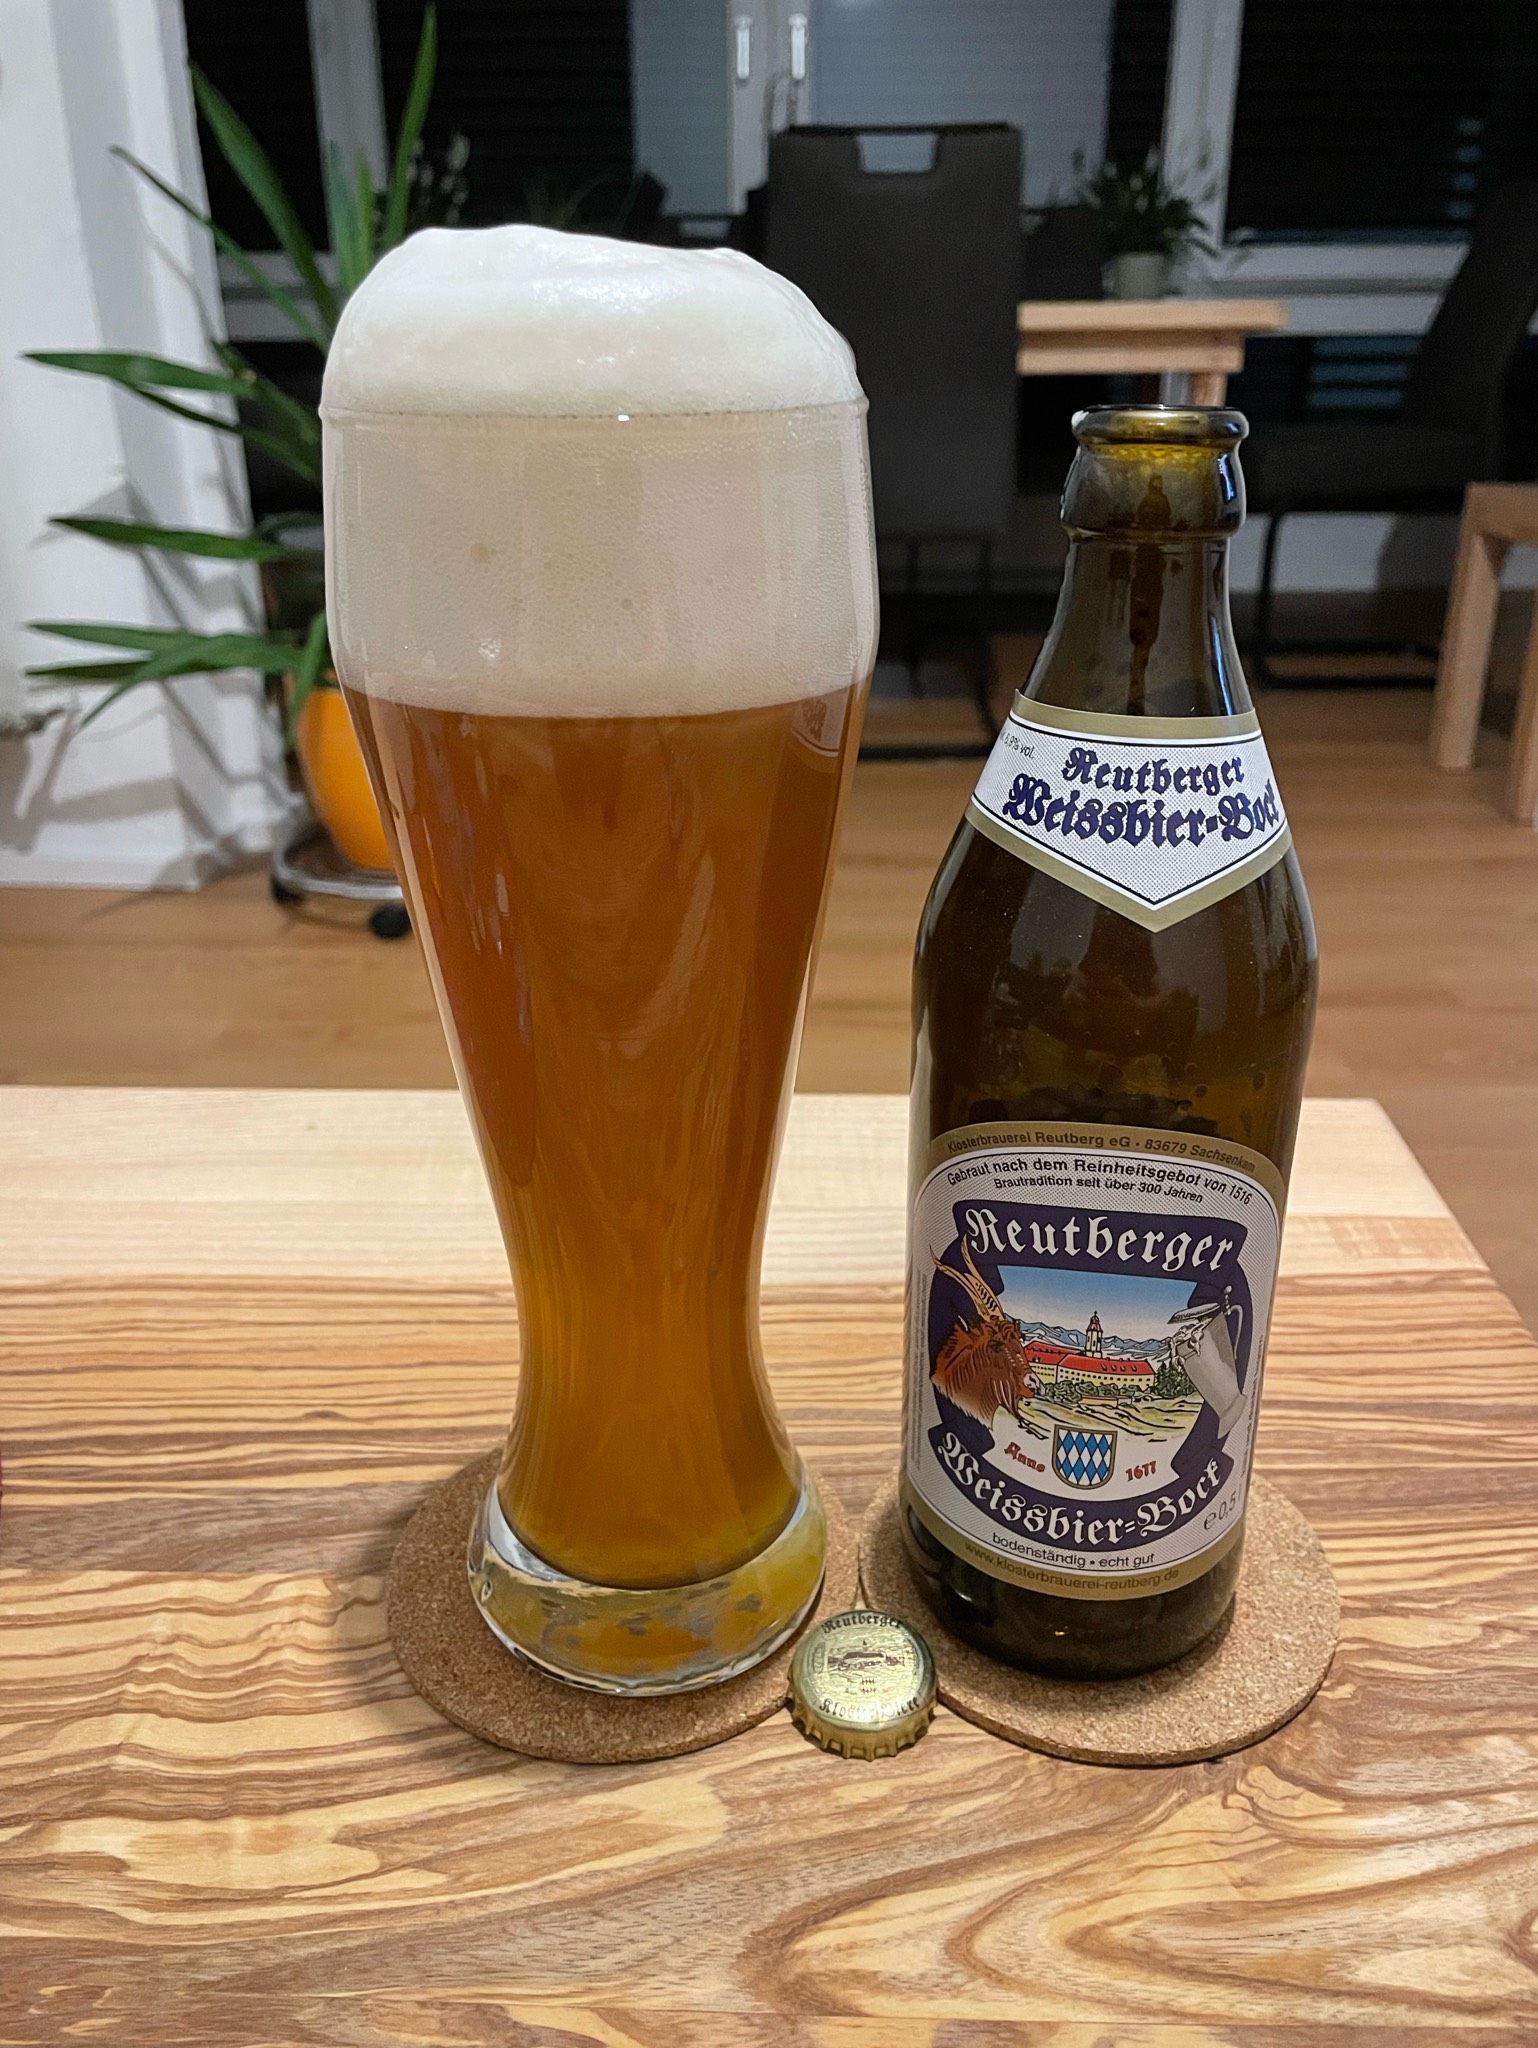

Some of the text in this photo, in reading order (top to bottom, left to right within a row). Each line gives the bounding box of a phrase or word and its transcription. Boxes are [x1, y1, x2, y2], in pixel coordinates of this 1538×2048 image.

[1062, 747, 1245, 796] Reutberger
[947, 1131, 1256, 1173] Klosterbrauerei Reutberg eG 83679 Sachsenkam
[947, 1157, 1253, 1205] Gebraut nach dem Reinheitsgebot von 1516
[994, 1174, 1204, 1204] Brautradition seit über 300 Jahren
[963, 1208, 1234, 1272] Reutberger
[1003, 1441, 1157, 1482] Anno 1677
[964, 1541, 1180, 1590] www.klosterbrauerei-reutberg.de
[992, 1531, 1155, 1568] bodenständig echt gut
[821, 1612, 903, 1634] Reutberger
